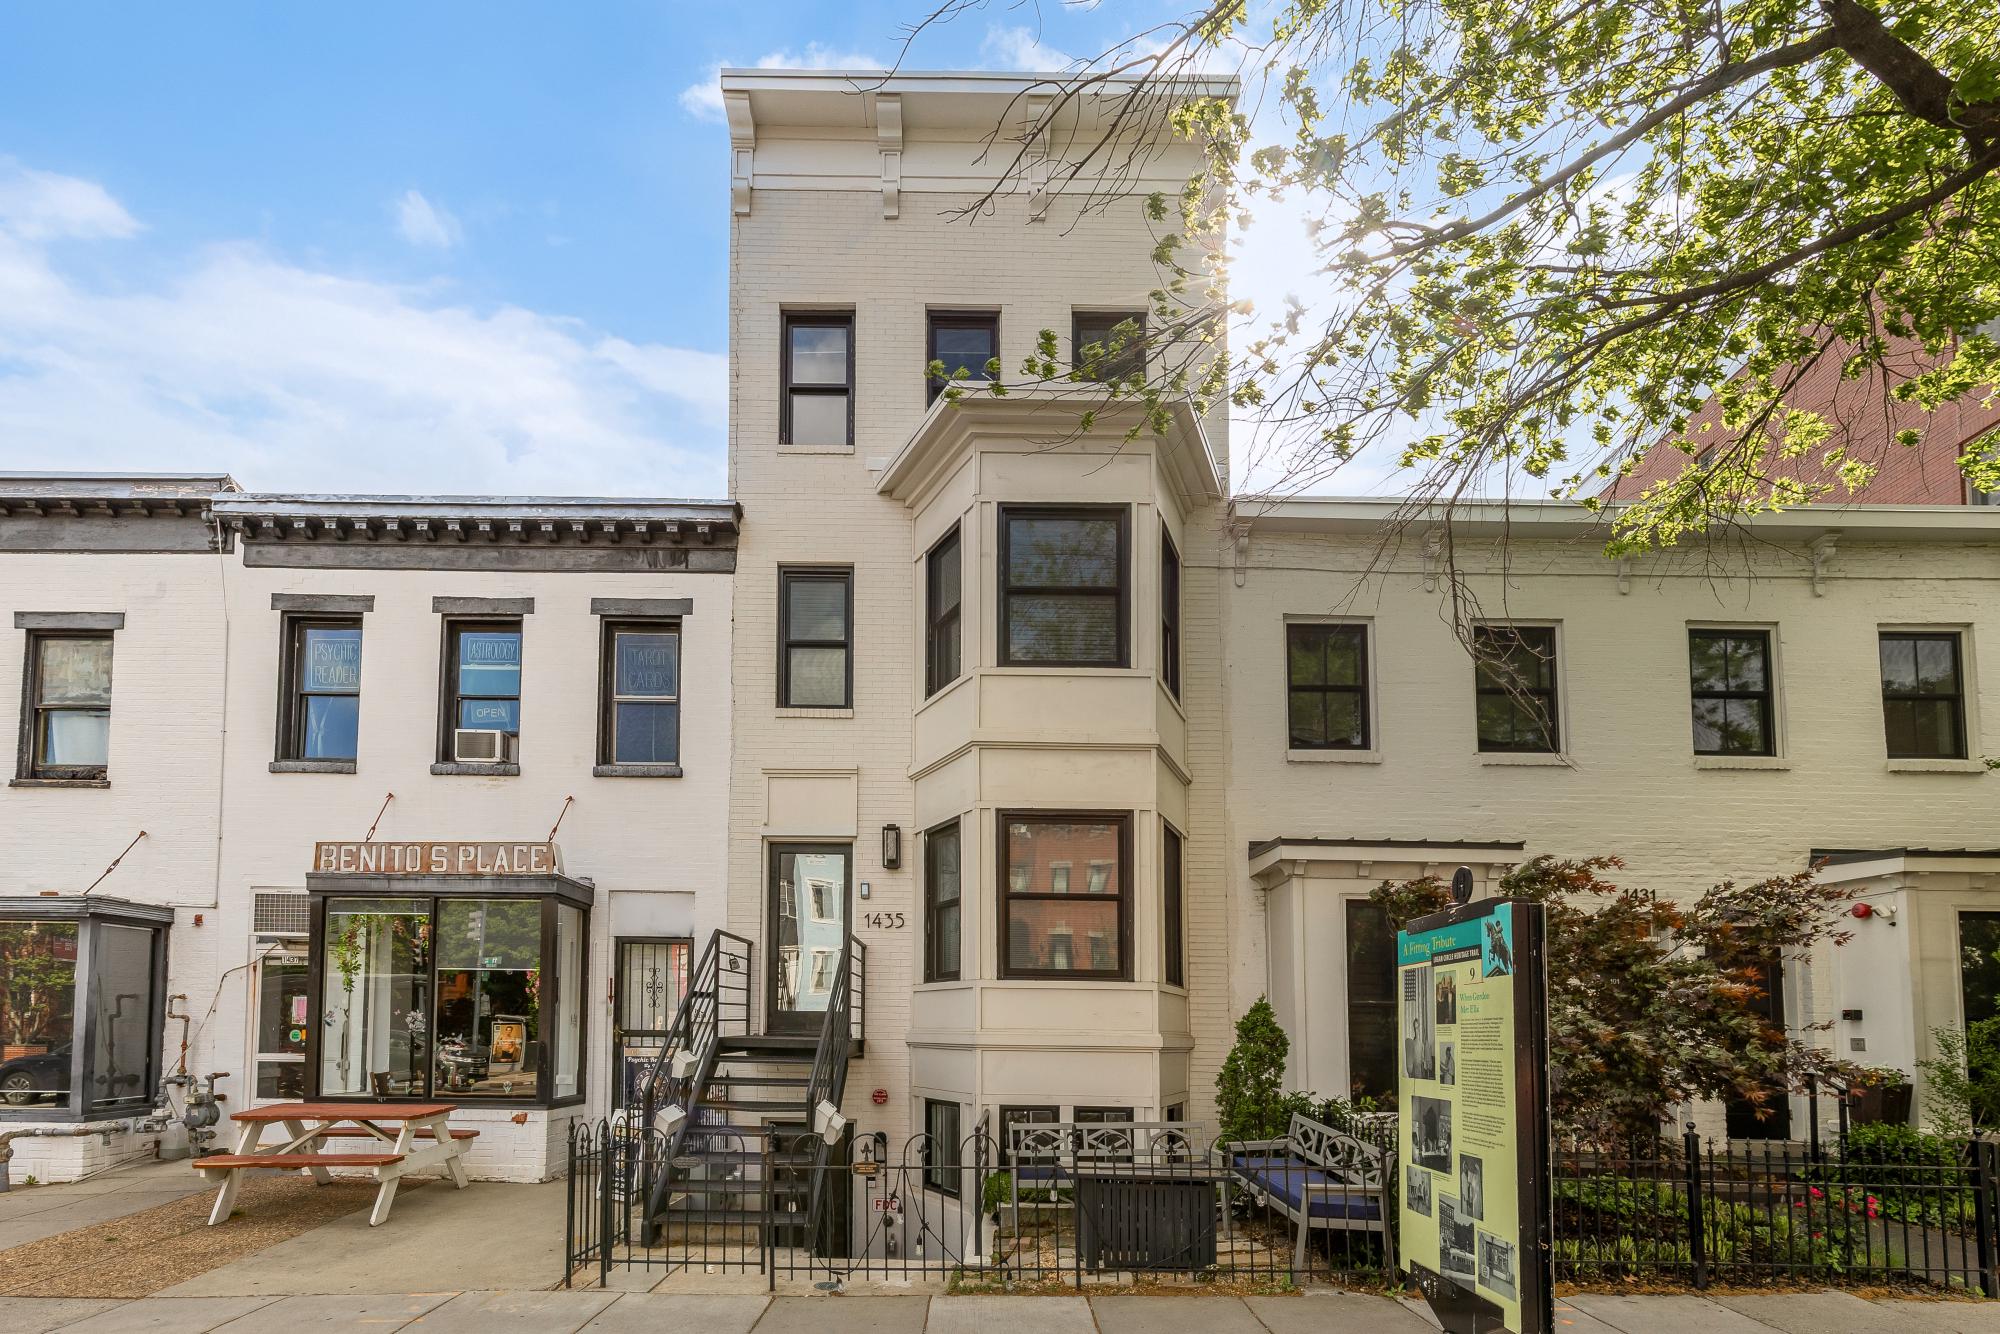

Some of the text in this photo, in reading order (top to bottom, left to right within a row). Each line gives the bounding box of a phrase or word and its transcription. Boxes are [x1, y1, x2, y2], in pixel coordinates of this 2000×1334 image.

[313, 642, 357, 660] PSYCHIC
[470, 641, 515, 660] ASTROLOGY
[631, 648, 665, 666] TAROT
[314, 665, 357, 683] READER
[628, 671, 671, 689] CARDS
[476, 707, 505, 718] OPEN
[319, 844, 548, 873] BENITO'S PLACE
[1622, 888, 1656, 901] 1431
[864, 912, 905, 929] 1435
[1432, 935, 1457, 951] Tribute
[1469, 967, 1475, 981] 9
[627, 1056, 649, 1064] Psychic
[875, 1200, 897, 1211] FDC
